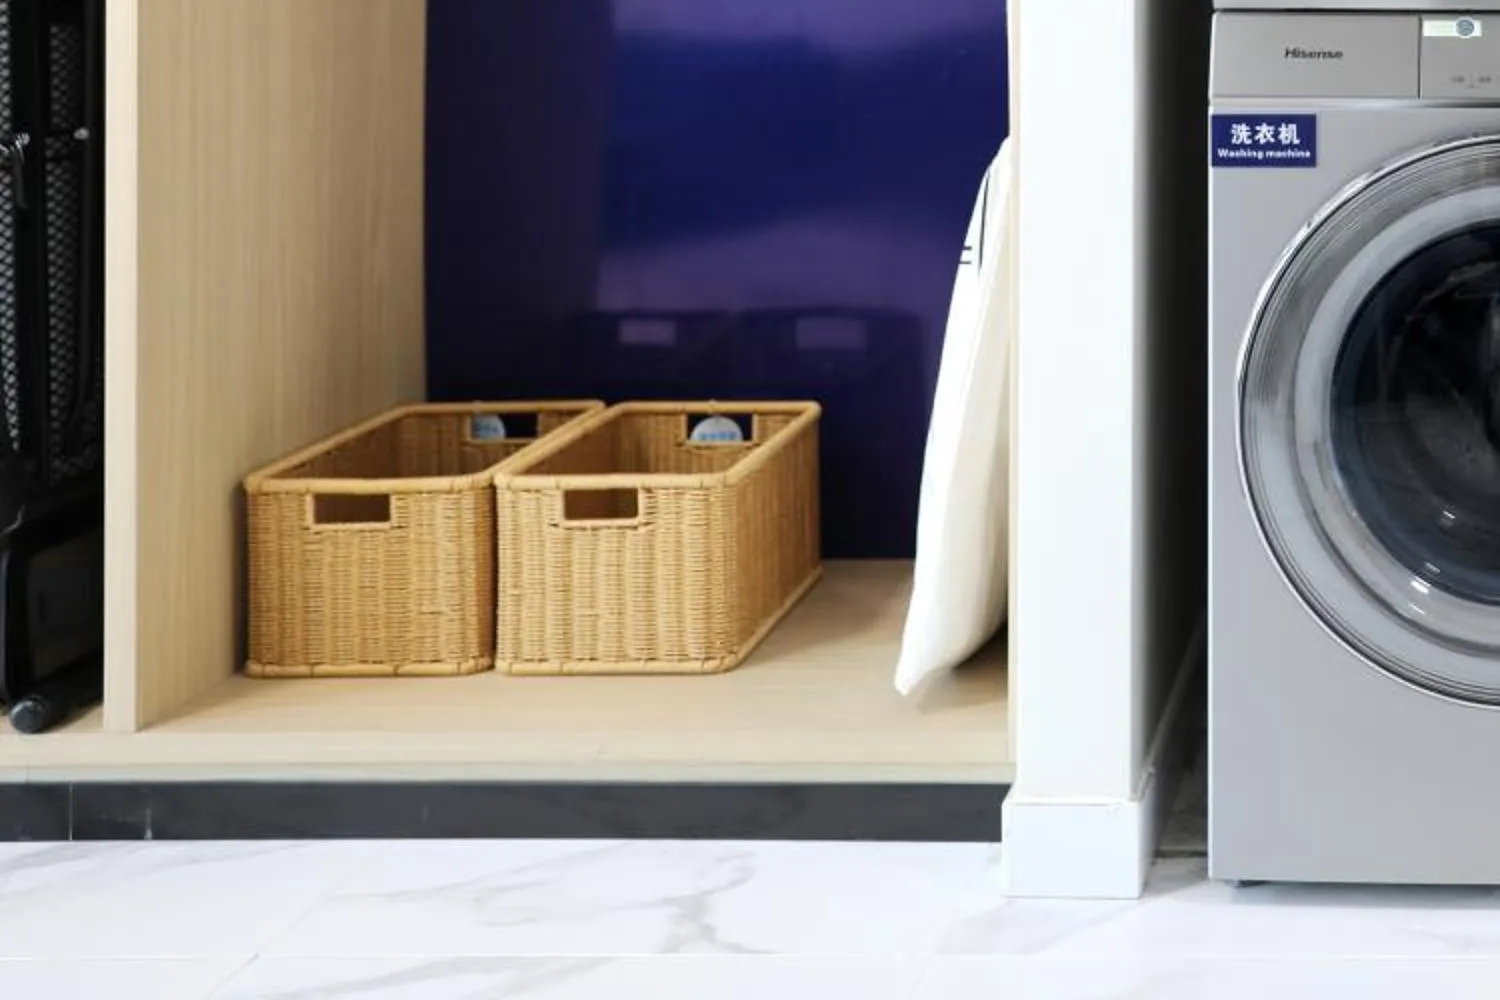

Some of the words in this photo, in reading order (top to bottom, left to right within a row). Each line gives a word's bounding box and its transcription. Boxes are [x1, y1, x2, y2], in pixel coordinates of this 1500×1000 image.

[1284, 47, 1344, 59] Hisense
[1231, 122, 1300, 146] 洗衣机
[1217, 147, 1264, 160] Washing
